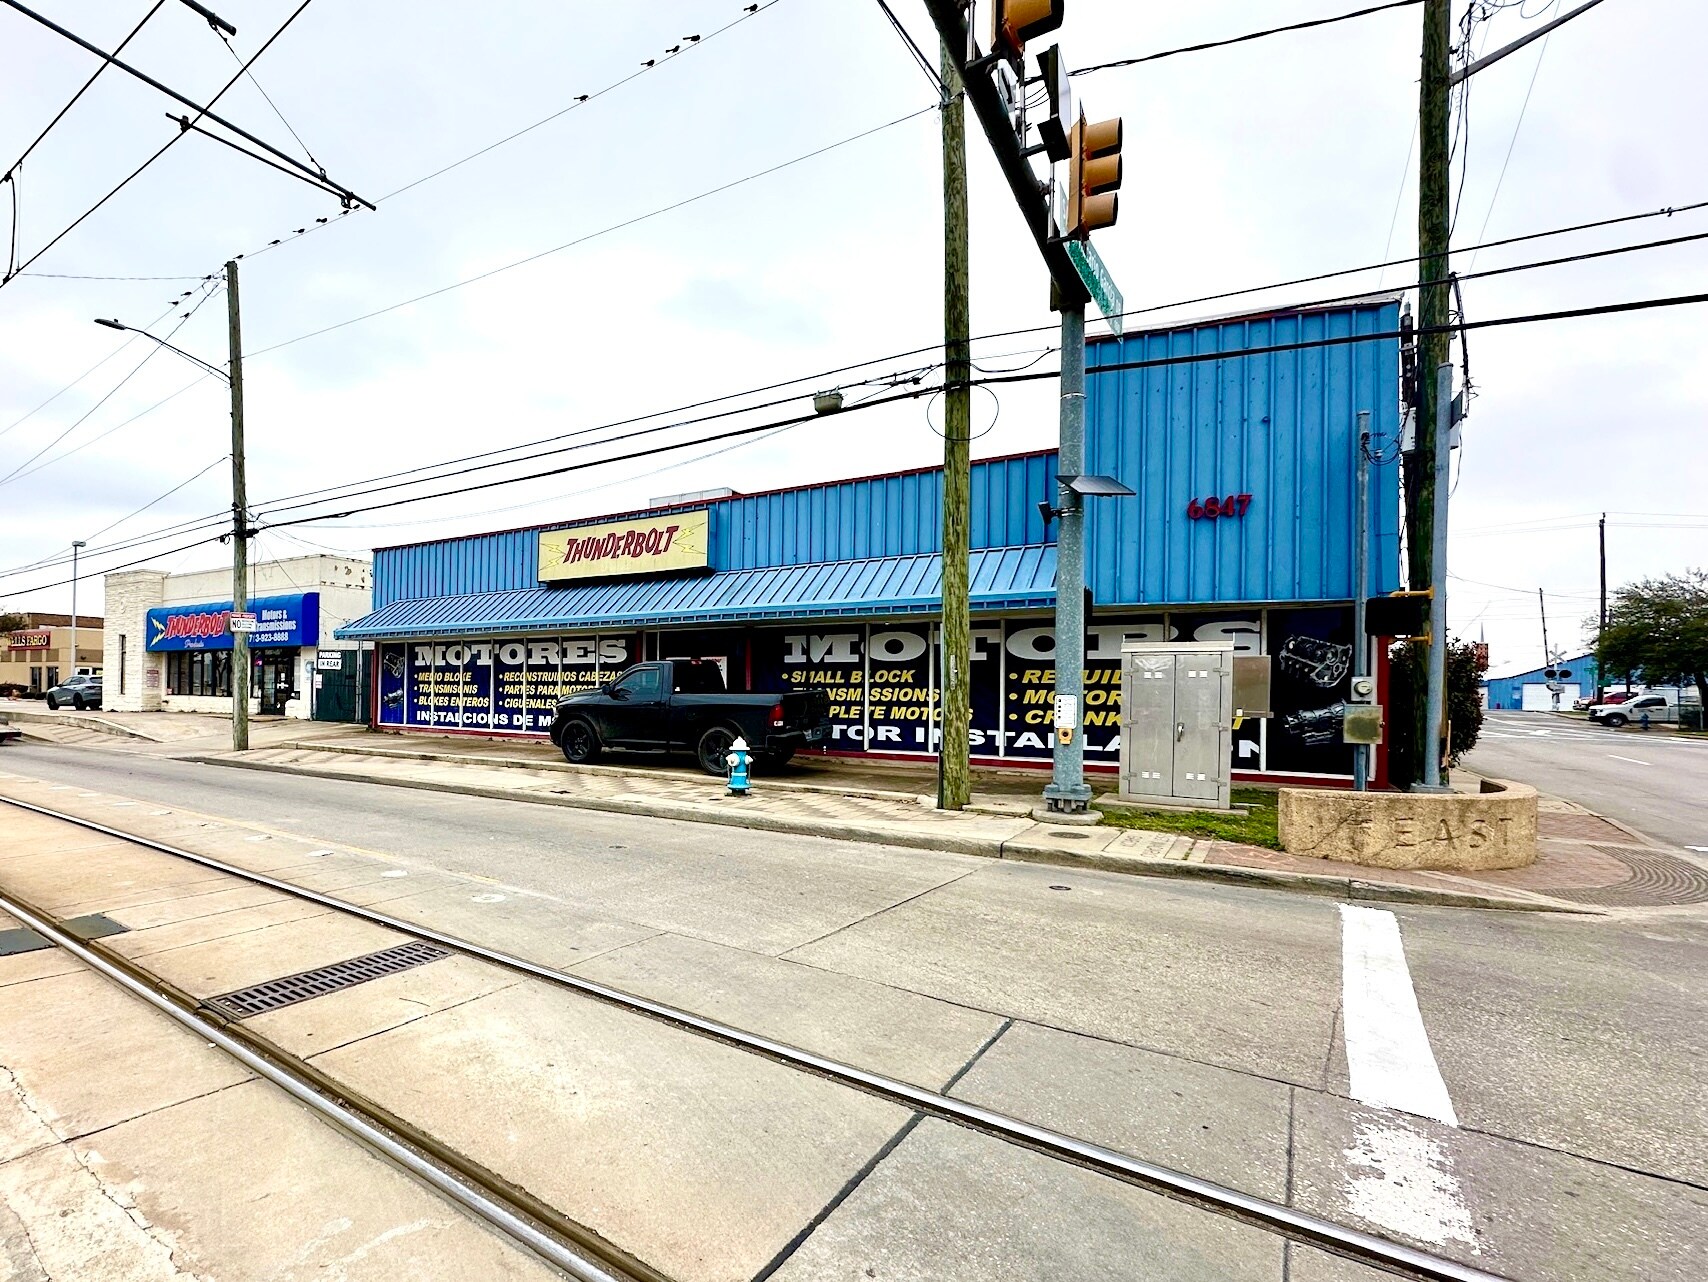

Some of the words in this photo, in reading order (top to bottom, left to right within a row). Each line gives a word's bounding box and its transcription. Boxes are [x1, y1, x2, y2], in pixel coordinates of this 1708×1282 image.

[1187, 494, 1252, 519] 6847
[563, 525, 680, 564] THUNDERBOLT
[164, 610, 231, 640] THUNDERBOLT
[10, 635, 26, 647] ELLS
[26, 634, 48, 647] FARGO
[414, 640, 628, 666] MOTORES
[418, 695, 449, 707] BLOKES
[449, 696, 490, 708] ENTEROS
[503, 685, 535, 695] PARTES
[536, 685, 560, 696] PARA
[512, 714, 534, 726] DE
[1393, 816, 1514, 851] EAST
